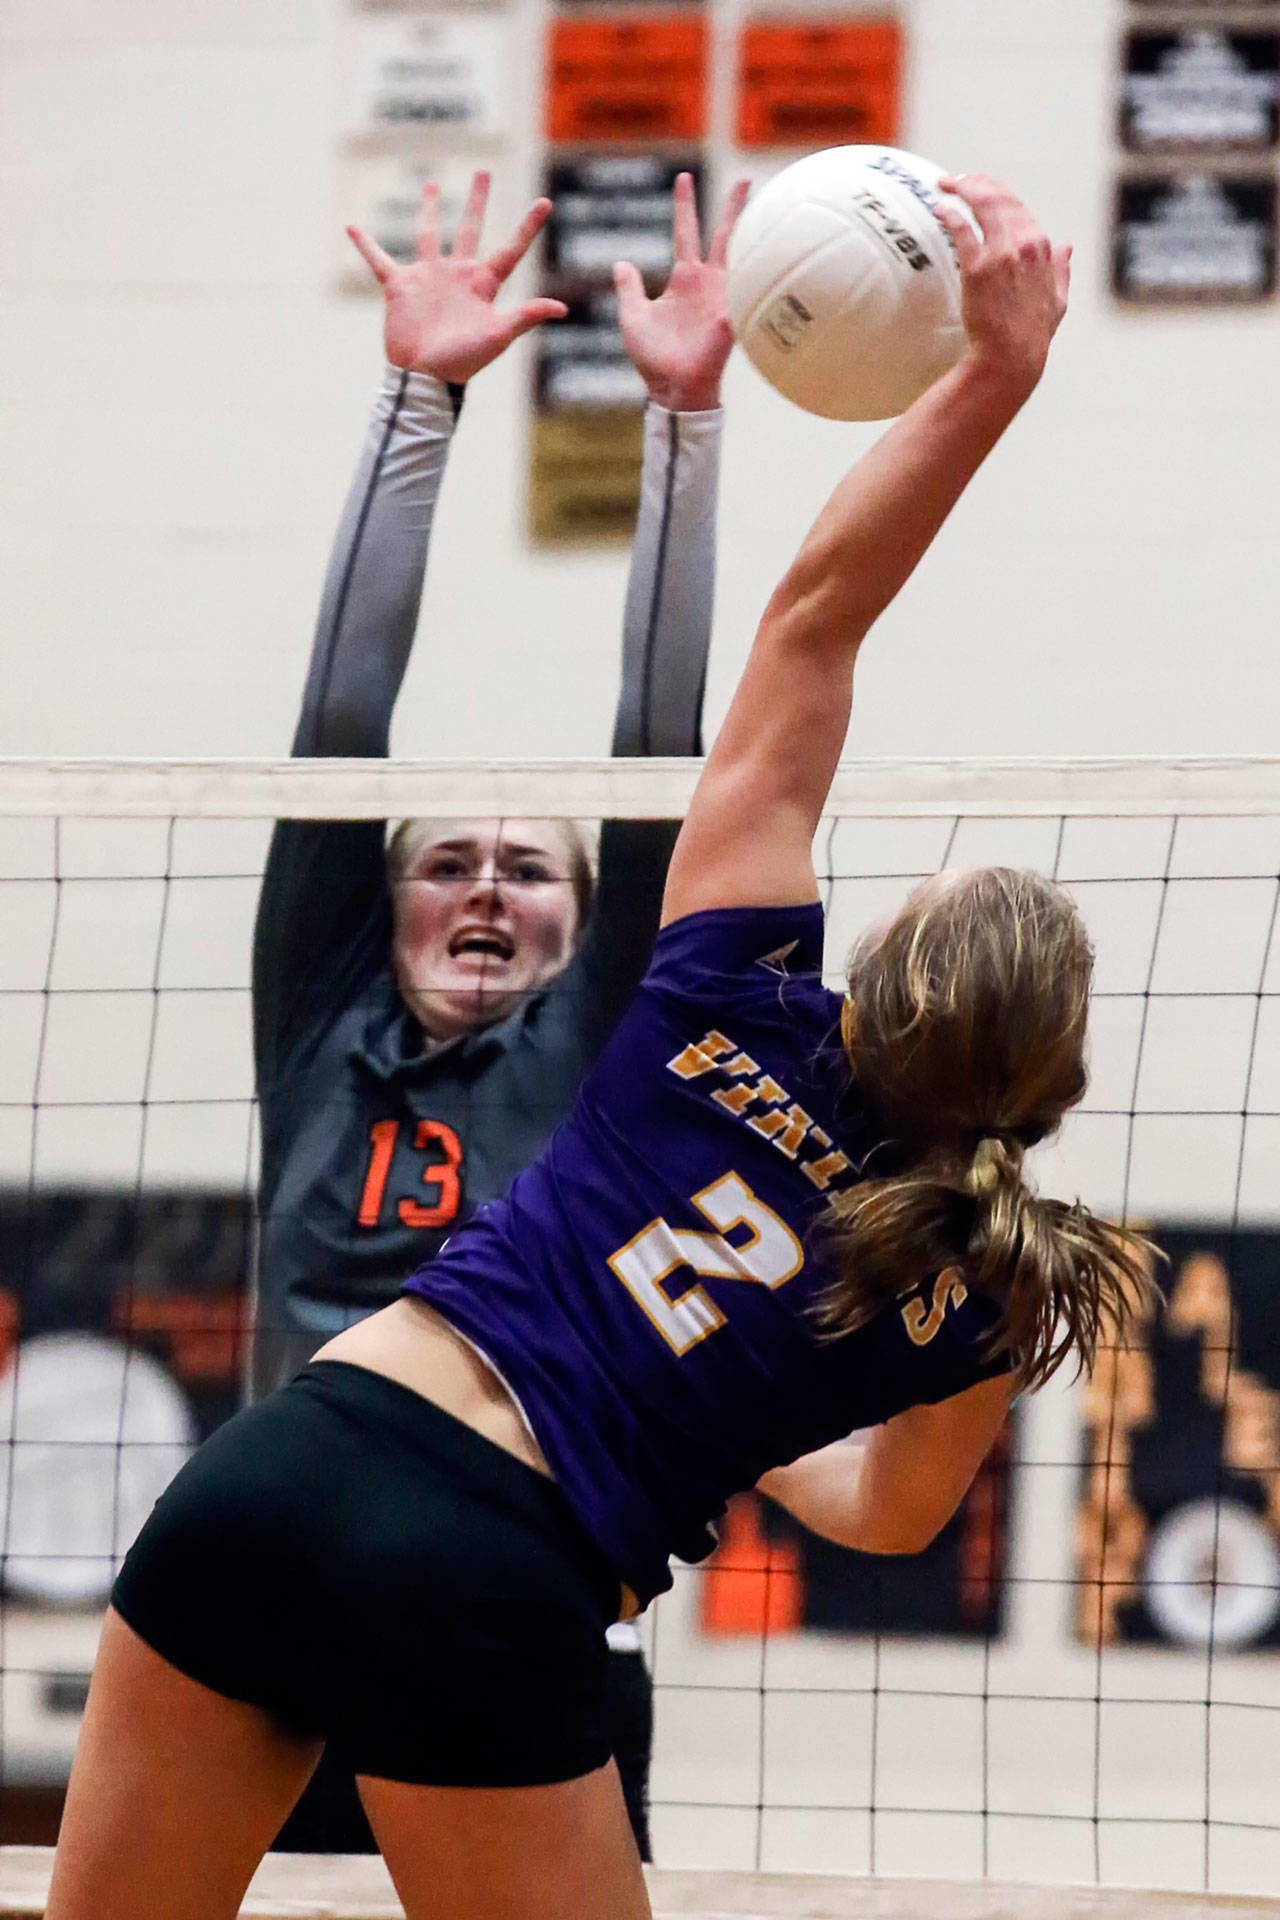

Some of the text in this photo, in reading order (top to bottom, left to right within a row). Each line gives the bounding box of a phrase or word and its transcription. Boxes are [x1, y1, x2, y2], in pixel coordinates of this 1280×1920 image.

[357, 1118, 463, 1228] 13
[607, 1170, 804, 1357] 2
[666, 1029, 968, 1346] VIKIS
